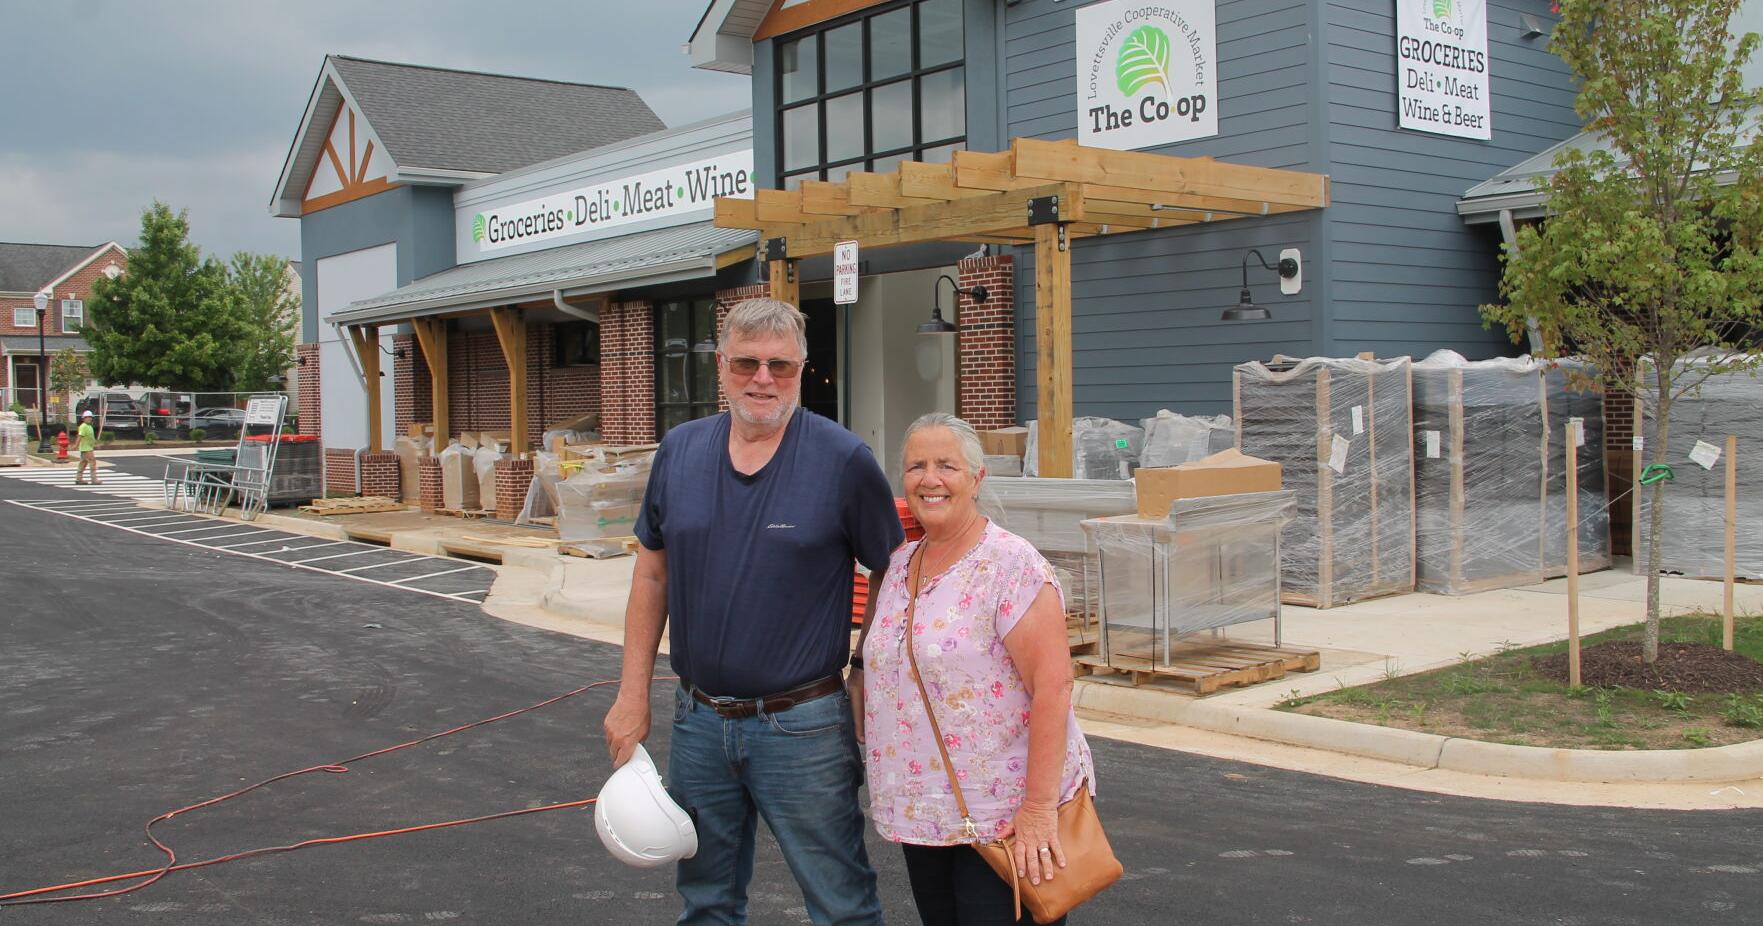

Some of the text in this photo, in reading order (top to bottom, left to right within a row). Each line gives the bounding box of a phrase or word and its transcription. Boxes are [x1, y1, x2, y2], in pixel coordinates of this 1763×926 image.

[1423, 17, 1439, 32] The
[1088, 6, 1207, 100] Lovettsville Cooperative Market
[1400, 36, 1484, 73] GROCERIES
[1407, 68, 1479, 100] Deli Meat
[1089, 105, 1132, 133] The
[1402, 97, 1483, 129] Wine & Beer
[488, 165, 747, 243] Groceries Deli Meat Wine
[836, 262, 856, 275] PARKING
[842, 249, 851, 261] NO
[840, 288, 852, 297] LANE
